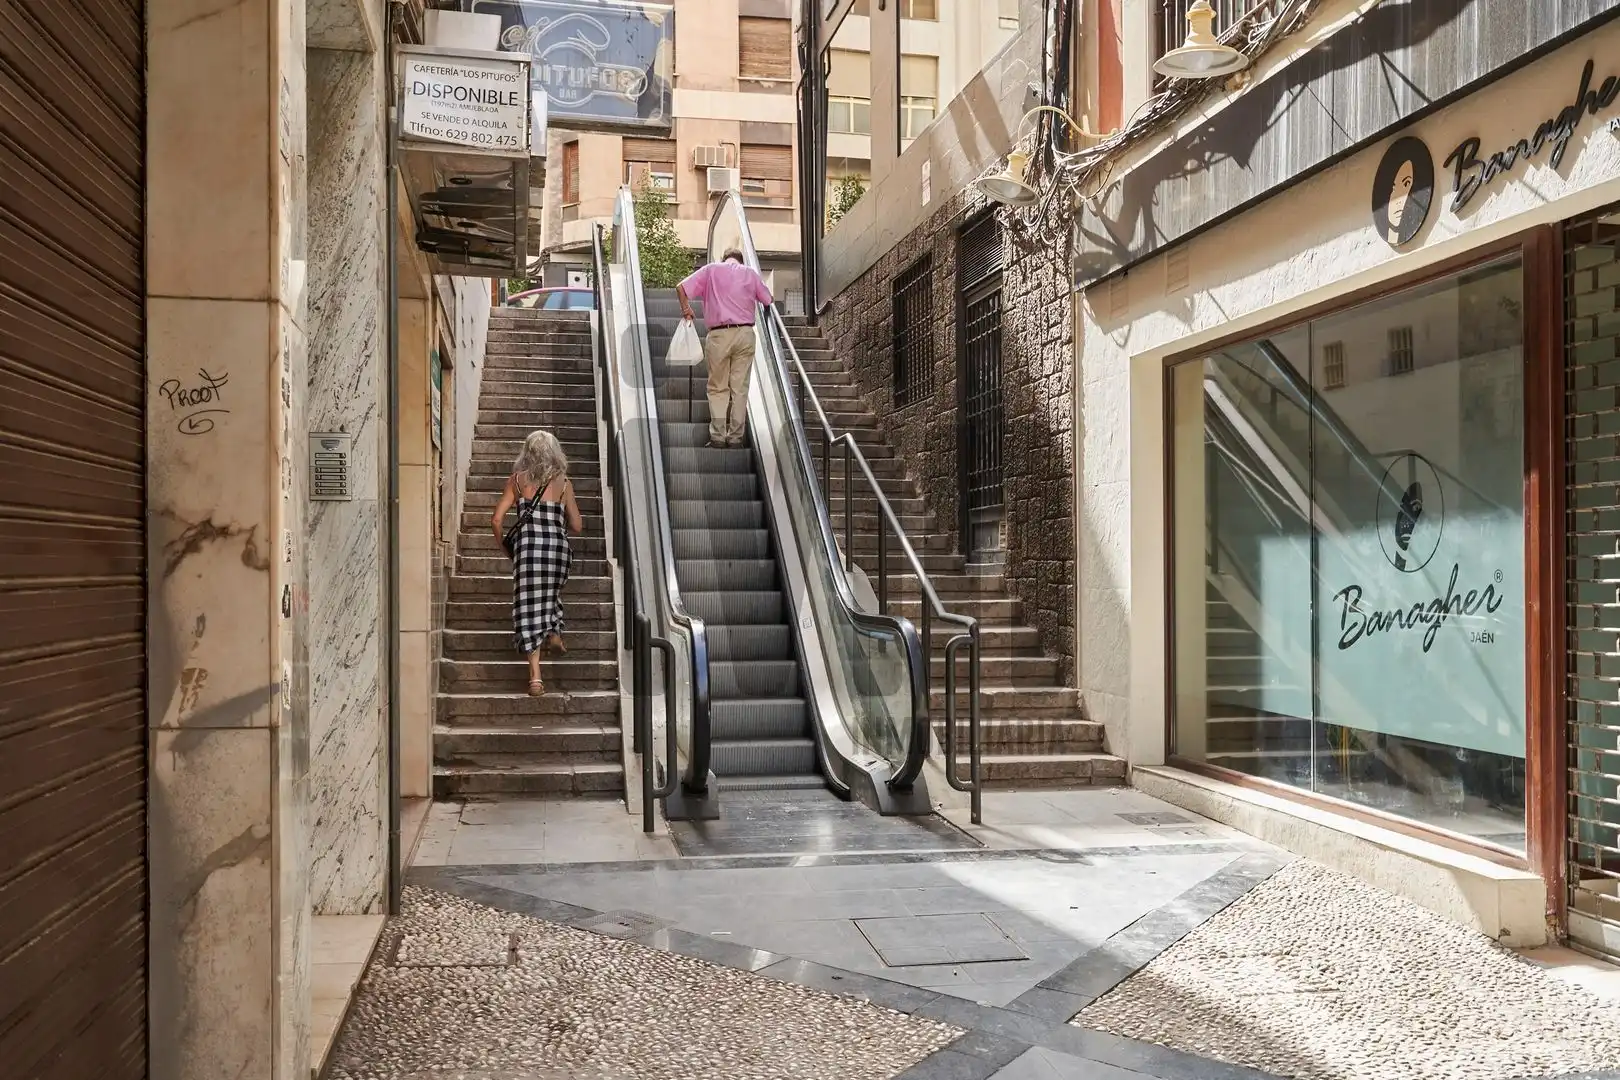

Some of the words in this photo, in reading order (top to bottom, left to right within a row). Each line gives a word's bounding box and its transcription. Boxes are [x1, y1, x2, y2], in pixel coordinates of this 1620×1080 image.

[413, 64, 459, 77] CAFETERÍA
[412, 80, 519, 107] DISPONIBLE
[458, 103, 499, 114] AMUEBLADA
[421, 111, 431, 120] SE
[432, 113, 461, 125] VENDE
[462, 117, 470, 125] O
[471, 119, 508, 130] ALQUILA
[446, 128, 468, 141] 629
[471, 132, 493, 145] 802
[495, 135, 518, 146] 475
[1443, 59, 1620, 213] Banaghe
[1470, 630, 1495, 644] JAÉN
